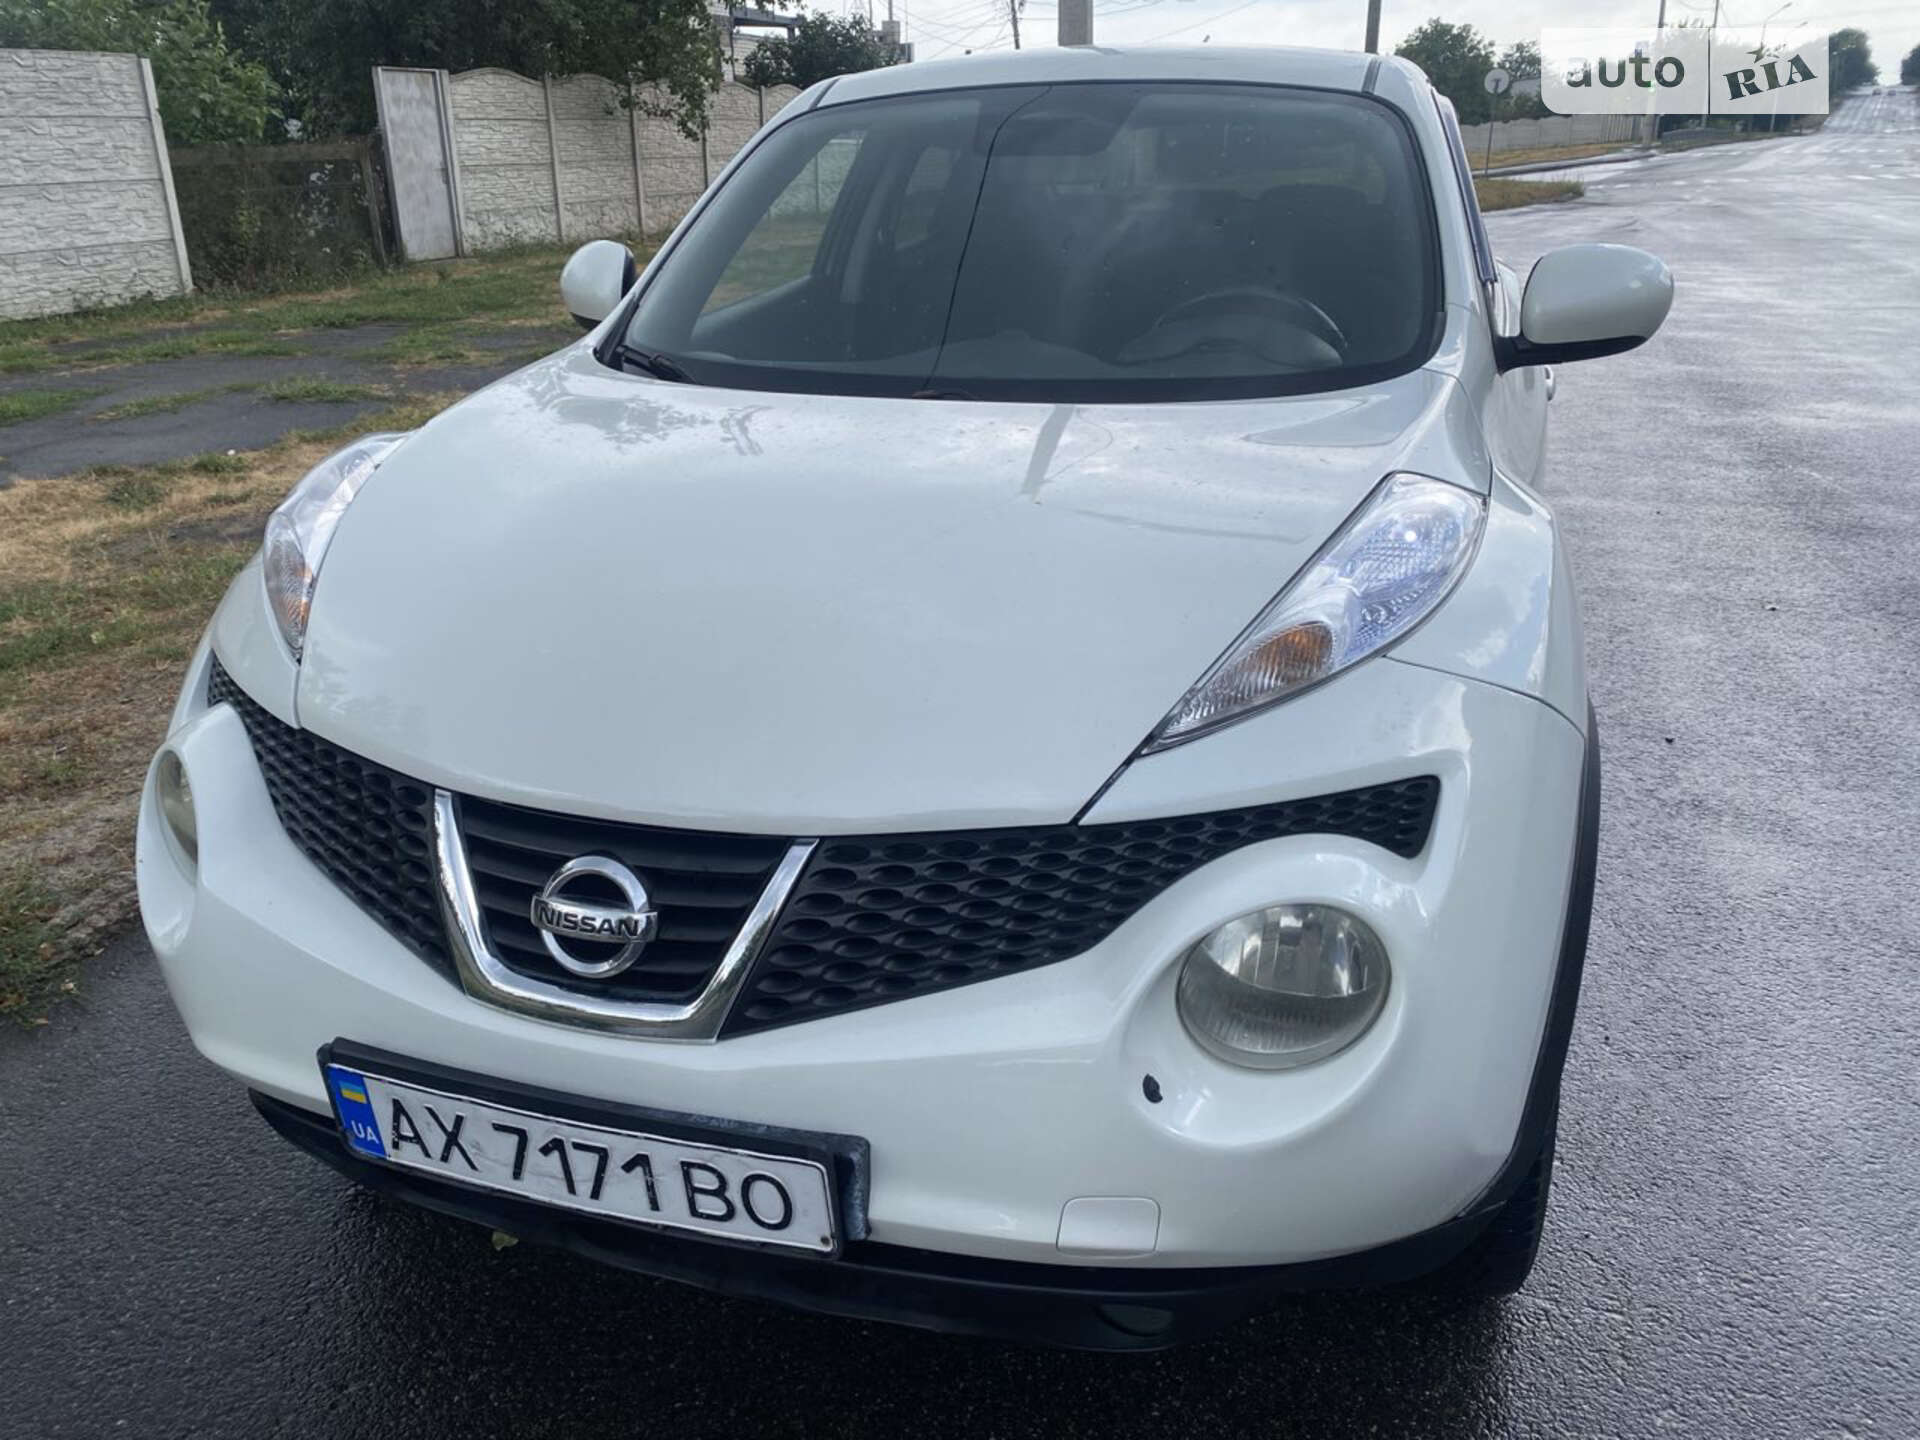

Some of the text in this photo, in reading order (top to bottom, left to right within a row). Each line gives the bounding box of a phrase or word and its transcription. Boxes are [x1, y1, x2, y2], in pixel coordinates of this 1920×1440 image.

[536, 901, 639, 937] NISSAN
[350, 1119, 379, 1146] UA
[391, 1098, 794, 1231] AX 7171 BO
